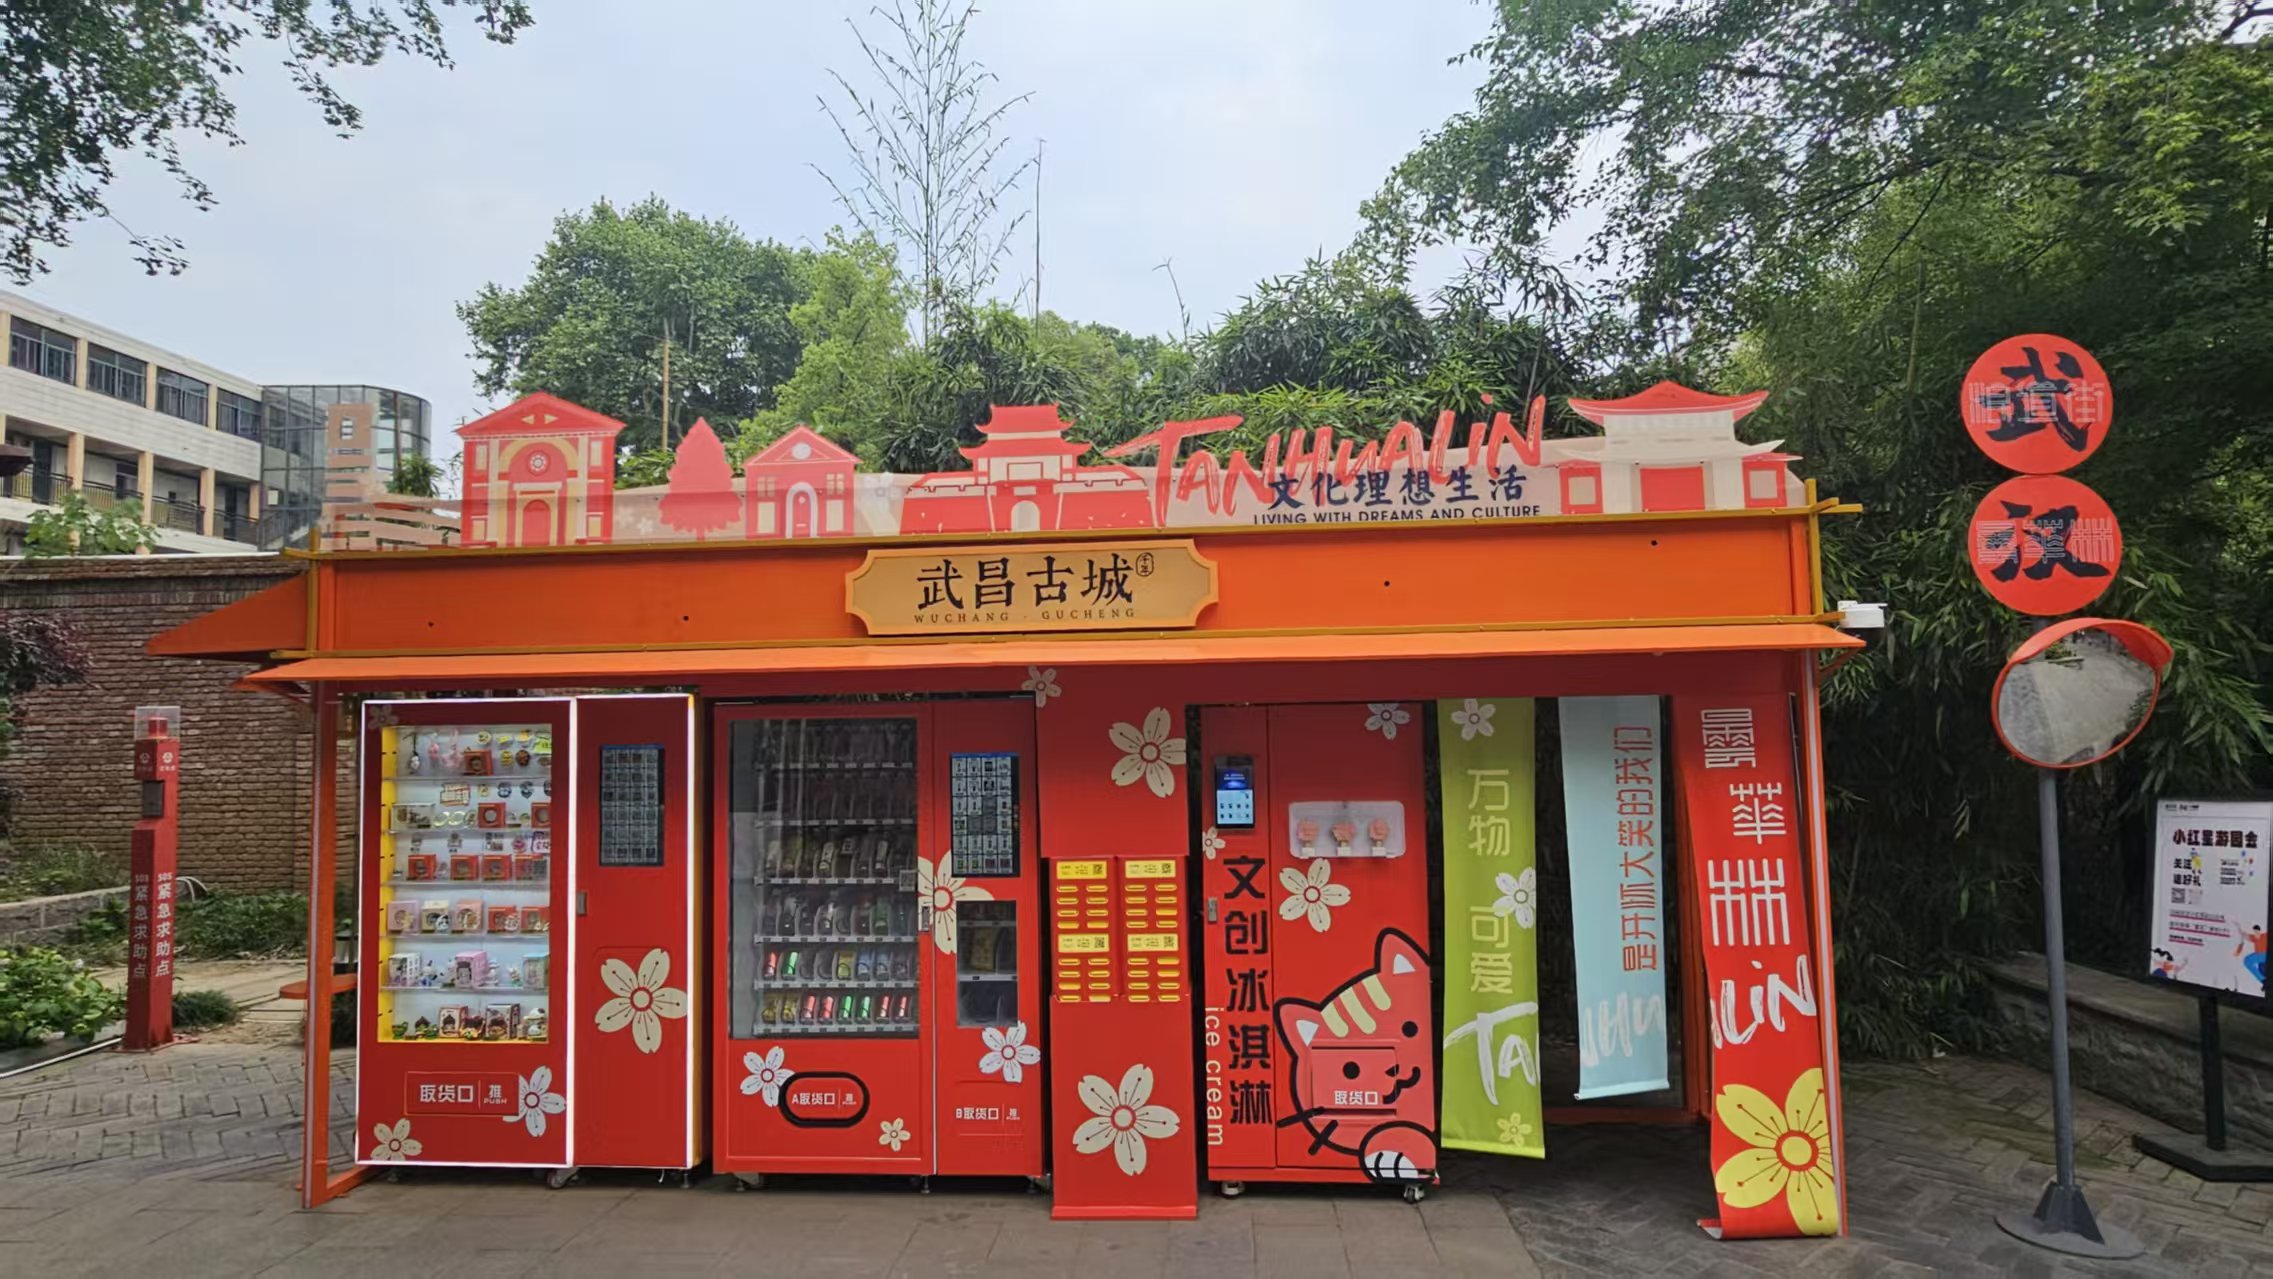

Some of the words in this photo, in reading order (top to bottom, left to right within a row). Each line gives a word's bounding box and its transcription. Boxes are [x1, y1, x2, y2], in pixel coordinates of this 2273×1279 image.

[1986, 346, 2088, 453] 武
[1268, 465, 1527, 510] 文化理想生活
[1314, 511, 1351, 523] WITH
[1359, 509, 1423, 521] DREAMS
[1431, 507, 1465, 520] AND
[1472, 504, 1541, 518] CULTURE
[916, 553, 1134, 610] 武昌古城
[1990, 500, 2112, 583] 汉
[914, 612, 1010, 624] WUCHANG
[1041, 608, 1136, 621] GUCHENG
[1466, 769, 1511, 856] 万物
[1614, 725, 1659, 972] 是开怀大笑的我们
[132, 884, 149, 978] 紧急求助点
[155, 883, 172, 977] 紧急求助点
[1469, 905, 1514, 994] 可爱
[1204, 1008, 1225, 1047] ice
[1223, 856, 1273, 1125] 文创冰淇淋
[420, 1085, 474, 1103] 取货口
[1205, 1060, 1225, 1146] cream
[1334, 1091, 1378, 1105] 取货口
